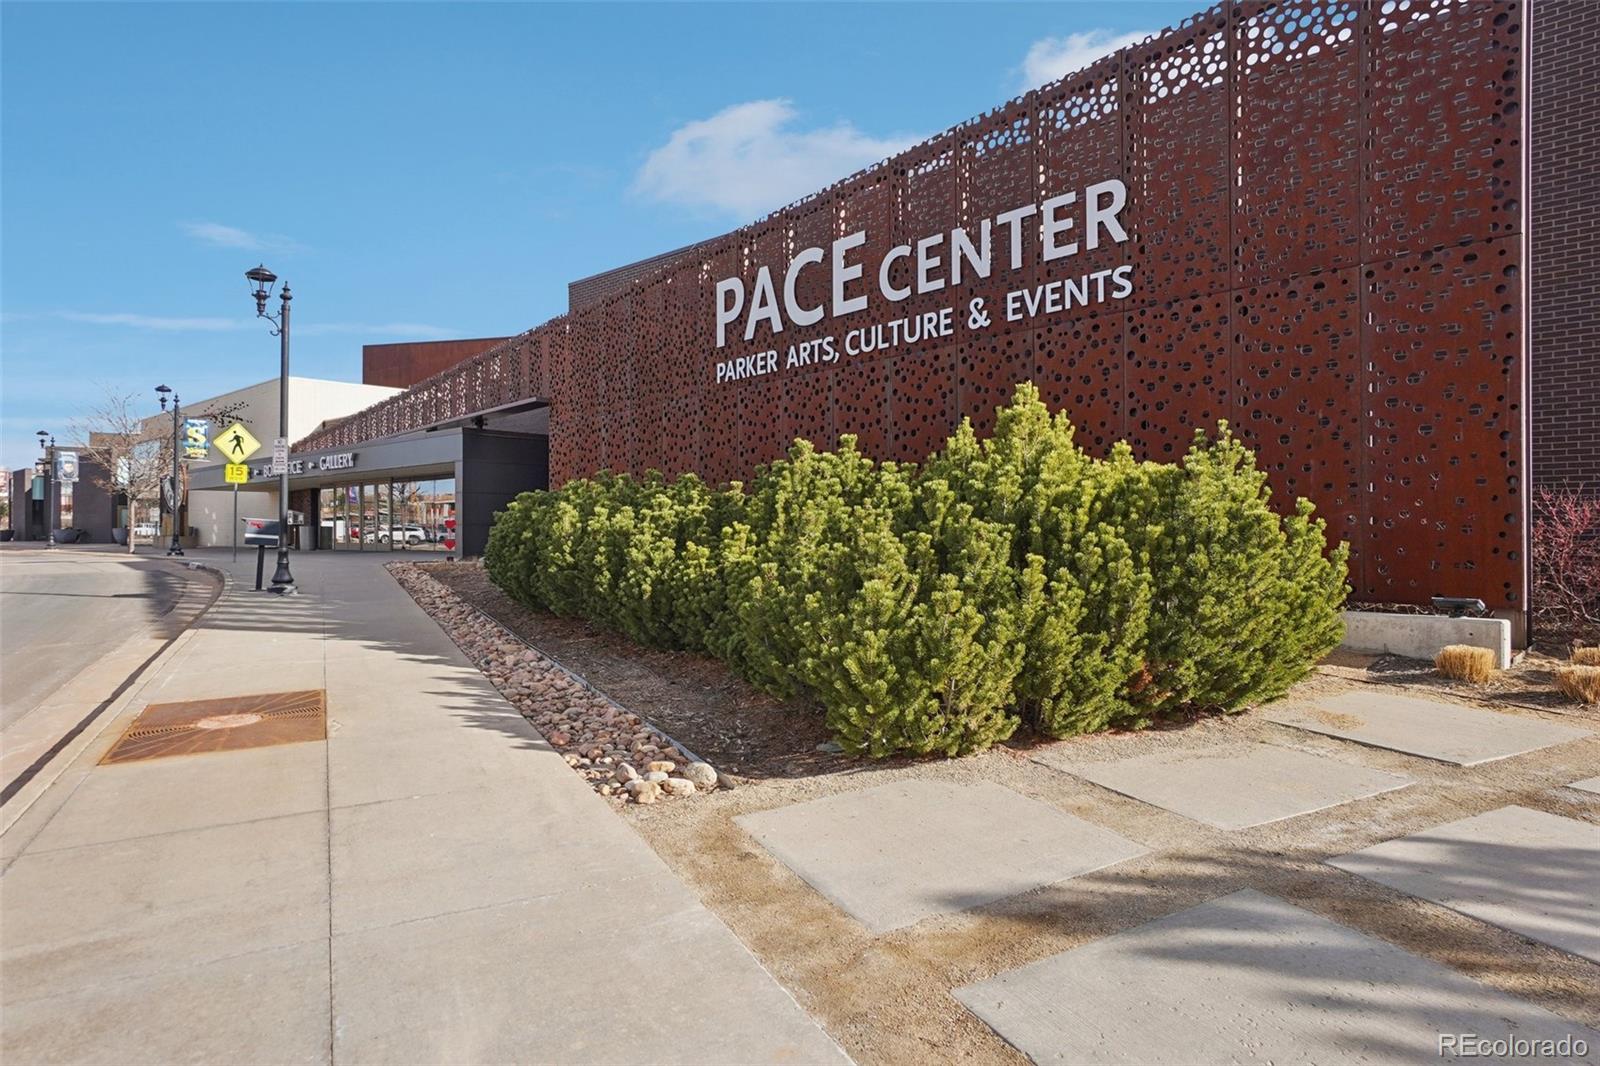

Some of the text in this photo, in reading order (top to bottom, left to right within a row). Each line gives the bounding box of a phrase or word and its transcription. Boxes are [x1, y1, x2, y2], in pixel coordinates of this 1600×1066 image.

[715, 179, 1130, 348] PACE CENTER
[716, 265, 1133, 384] PARKER ARTS, CULTURE & EVENTS
[230, 466, 244, 476] 15
[320, 452, 354, 470] GALLERY
